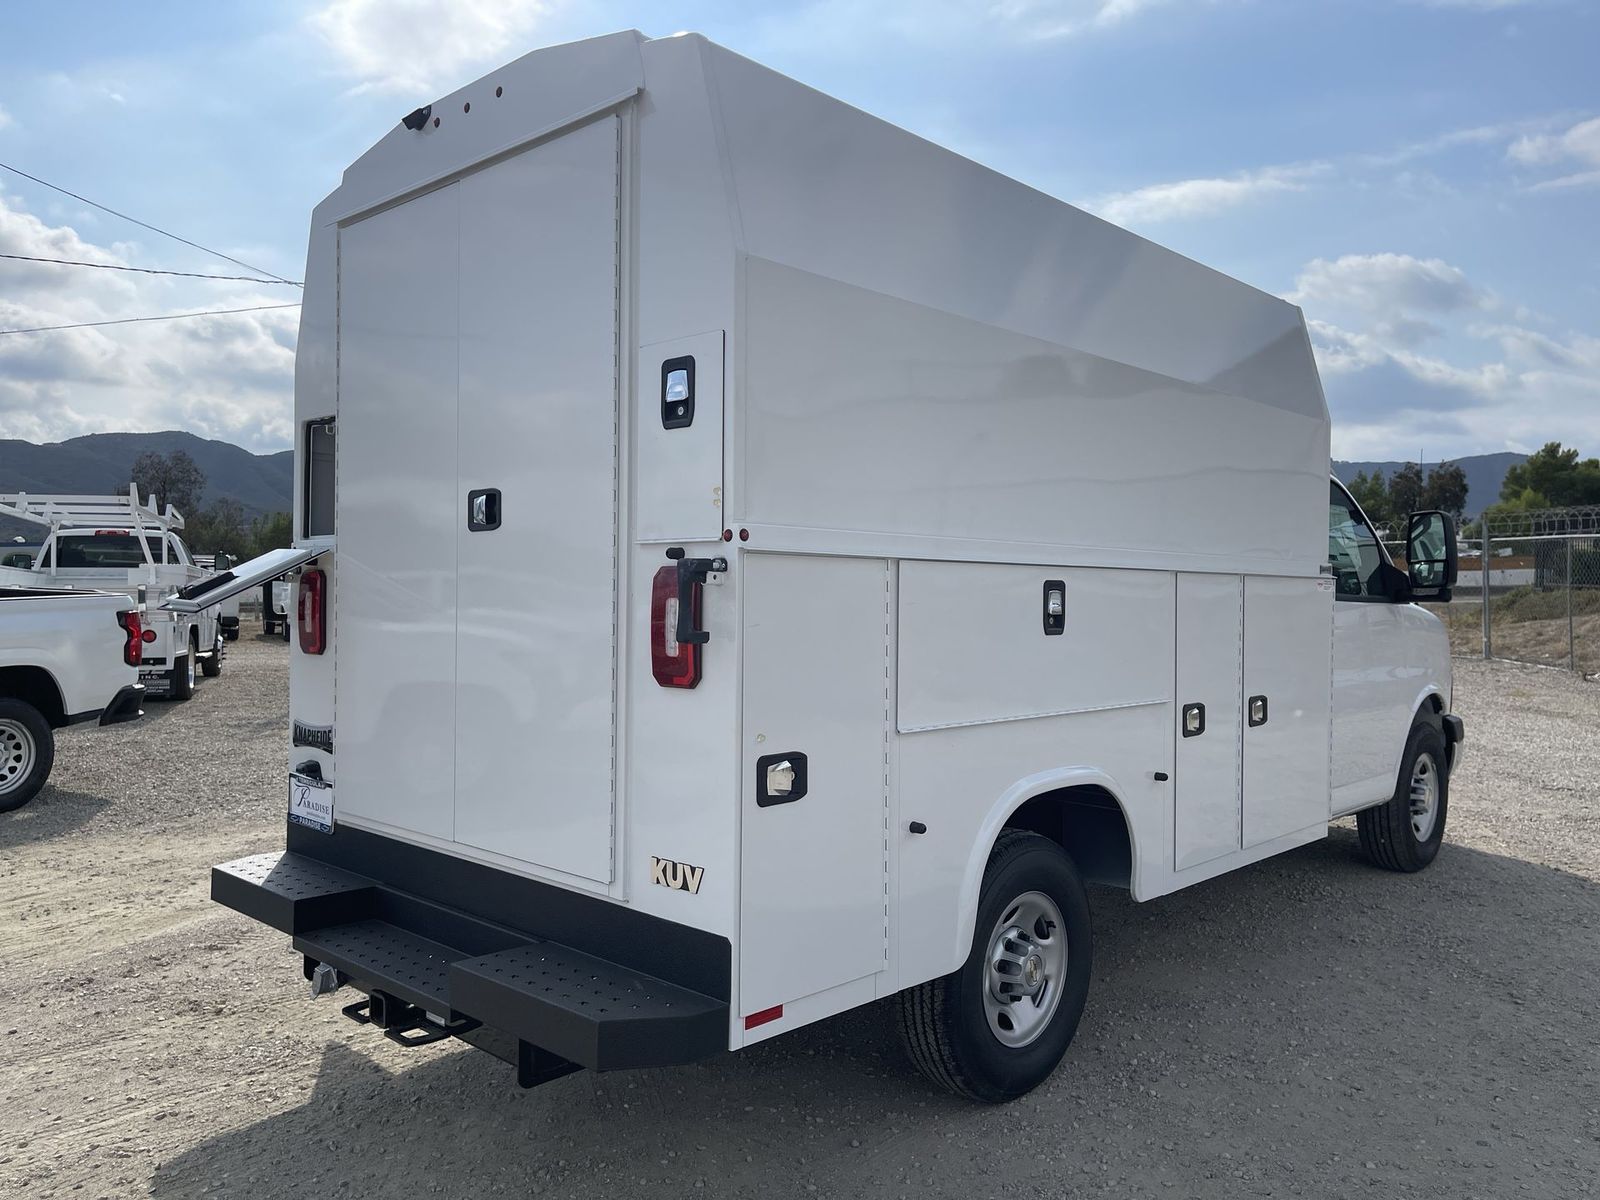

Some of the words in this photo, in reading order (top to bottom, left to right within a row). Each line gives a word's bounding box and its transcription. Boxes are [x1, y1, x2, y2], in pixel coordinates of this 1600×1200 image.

[294, 722, 332, 744] KNAPHEIDE
[294, 783, 330, 815] PARADISE
[651, 855, 705, 895] KUV
